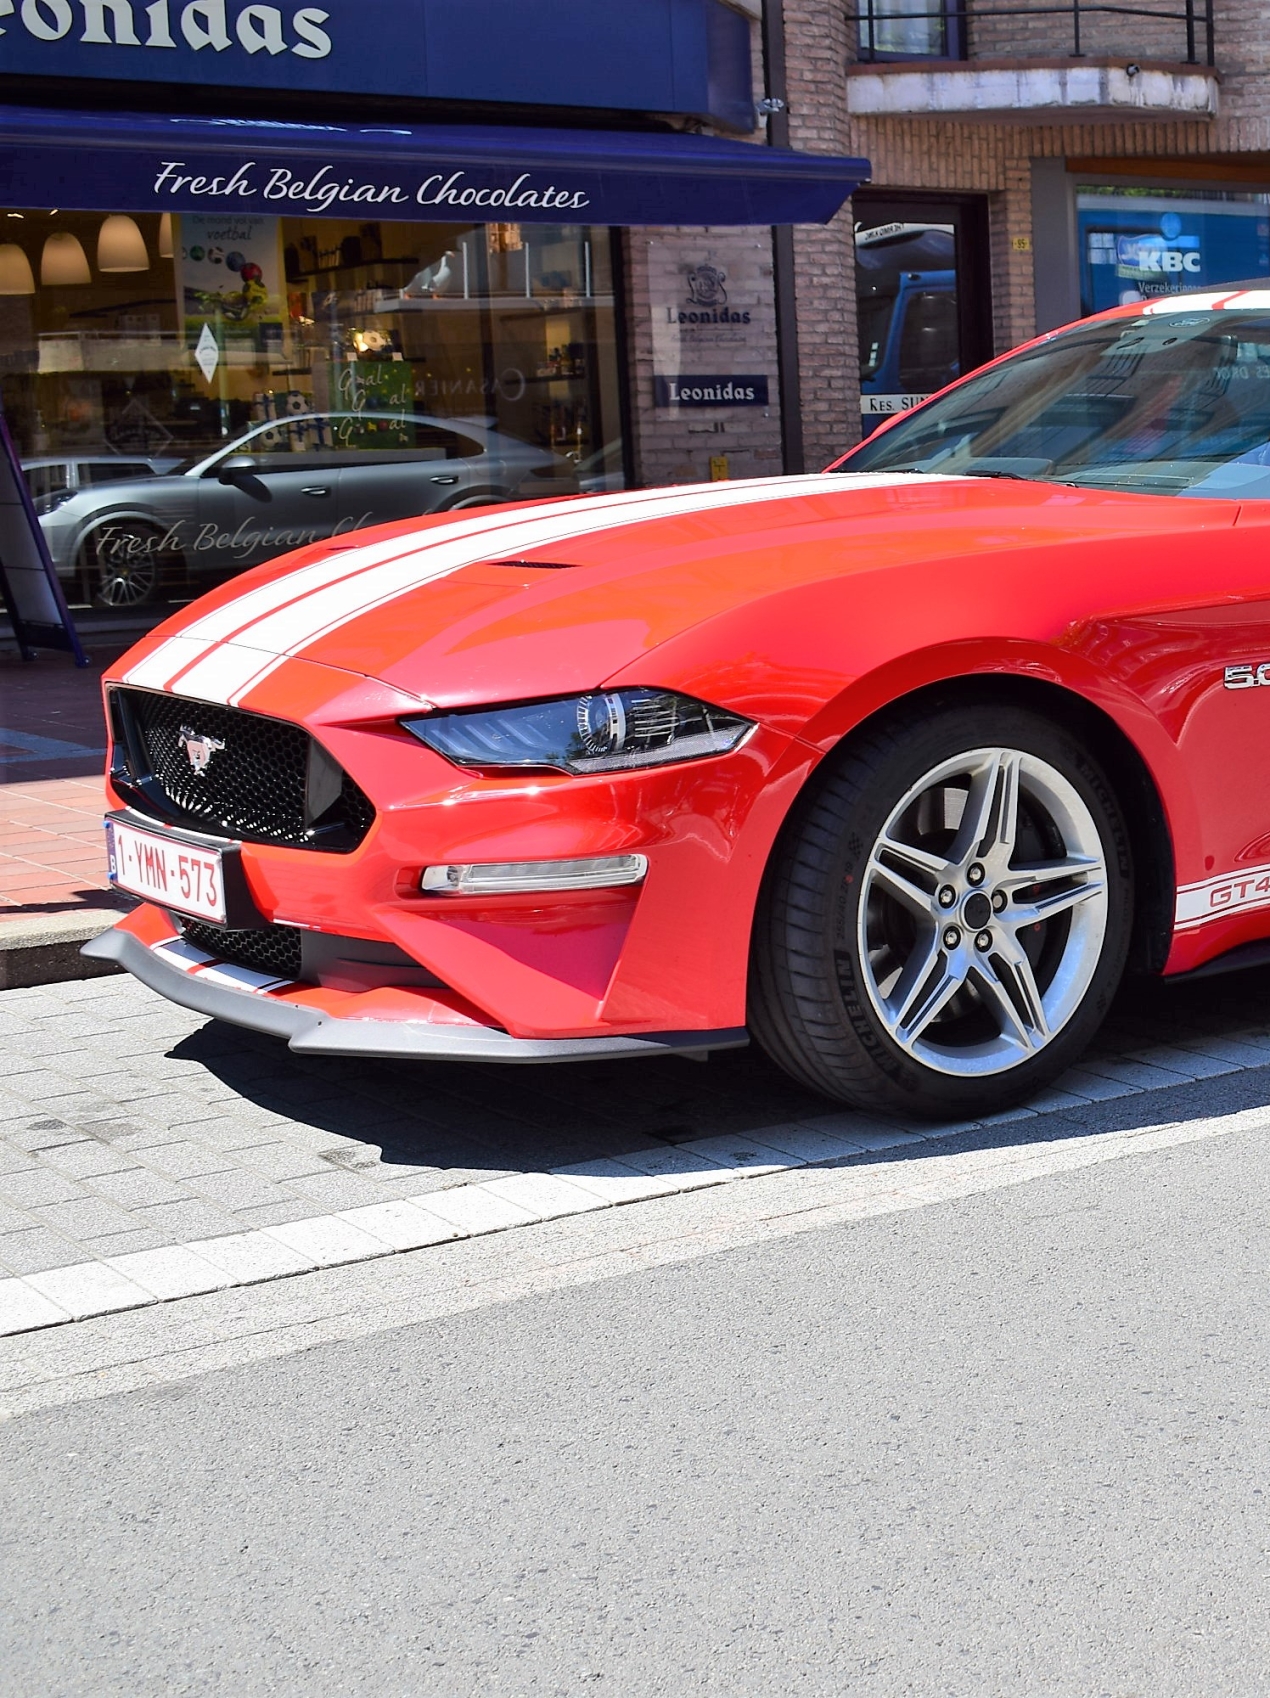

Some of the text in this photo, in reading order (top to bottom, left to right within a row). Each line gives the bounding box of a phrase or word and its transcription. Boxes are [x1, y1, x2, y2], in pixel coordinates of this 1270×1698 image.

[153, 161, 590, 212] Fresh Belgian Chocolates
[207, 225, 252, 240] voetbal
[1138, 252, 1201, 272] KBC
[667, 307, 751, 324] Leonidas
[669, 380, 755, 401] Leonidas
[96, 519, 188, 556] Fresh
[193, 516, 322, 559] Belgian
[110, 855, 117, 873] B
[117, 834, 218, 907] 1-YMN-573
[835, 956, 902, 1078] MICHELIN
